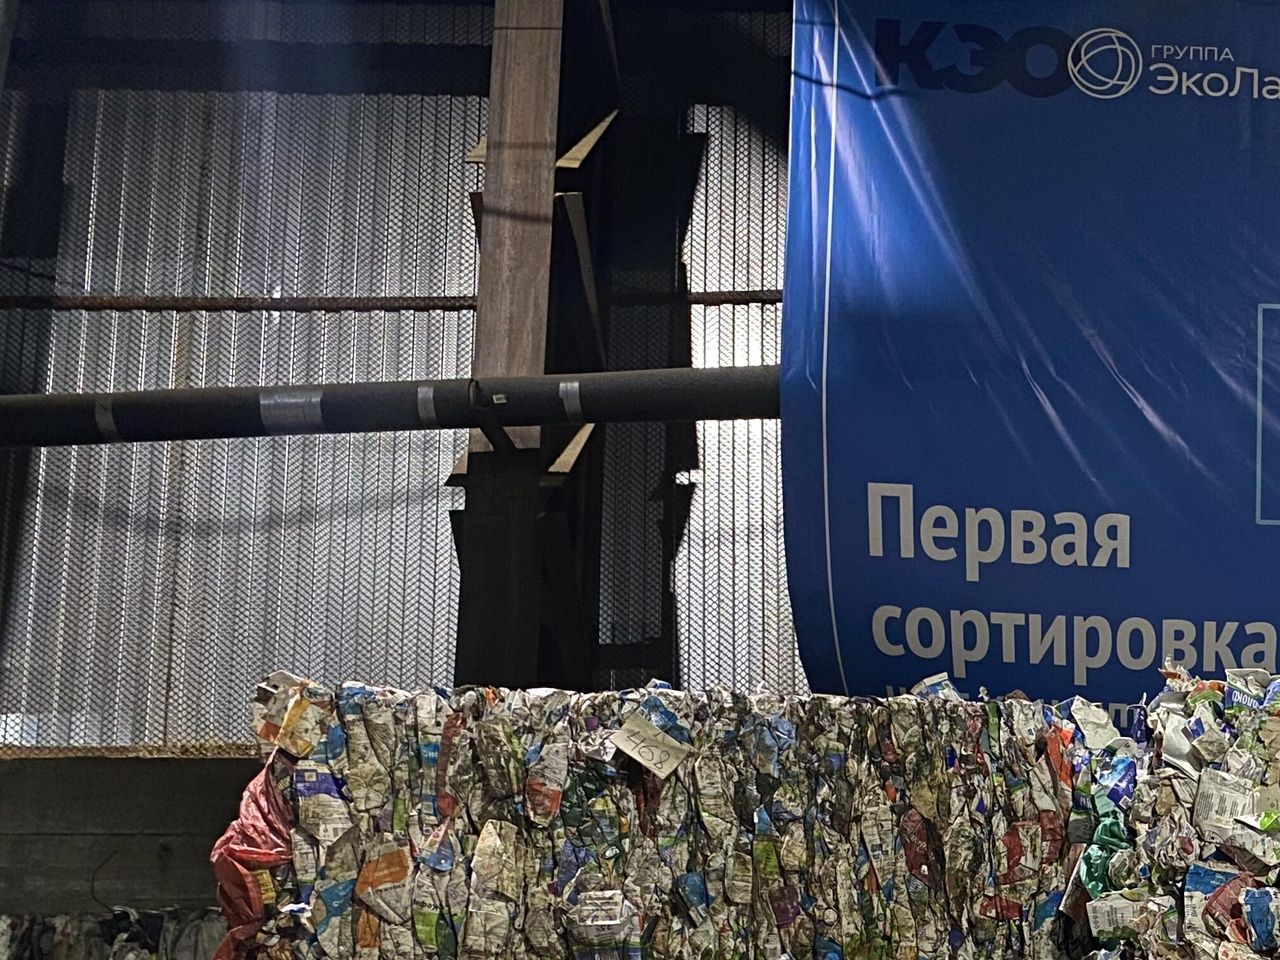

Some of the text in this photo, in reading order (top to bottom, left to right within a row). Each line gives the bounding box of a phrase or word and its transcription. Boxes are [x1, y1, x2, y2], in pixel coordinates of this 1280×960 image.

[1150, 44, 1235, 62] ГРУППА
[867, 482, 1131, 581] Первая
[871, 604, 1278, 686] сортировка
[625, 733, 672, 770] 468
